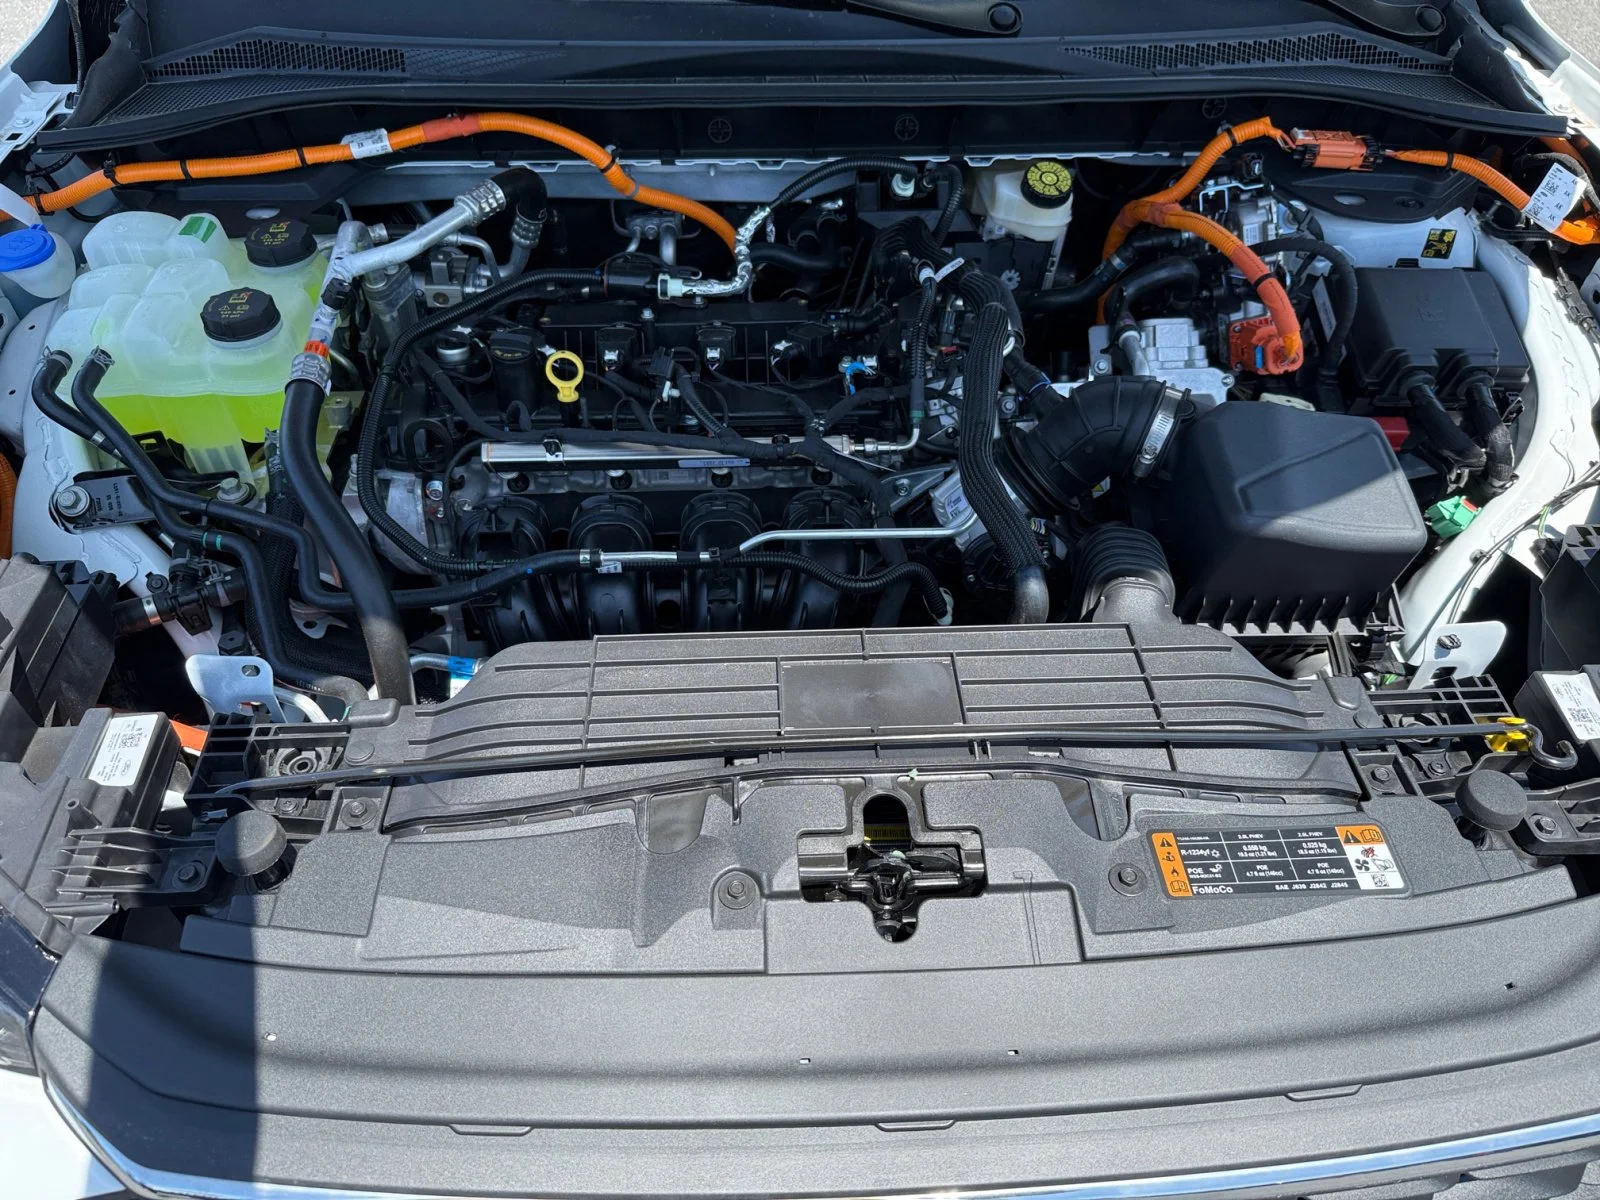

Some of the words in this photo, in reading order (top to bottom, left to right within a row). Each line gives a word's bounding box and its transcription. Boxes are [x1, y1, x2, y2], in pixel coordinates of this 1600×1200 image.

[1258, 844, 1268, 852] kg
[1318, 841, 1328, 849] kg
[1180, 848, 1211, 857] R-1234yf
[1192, 885, 1234, 894] FoMoCo
